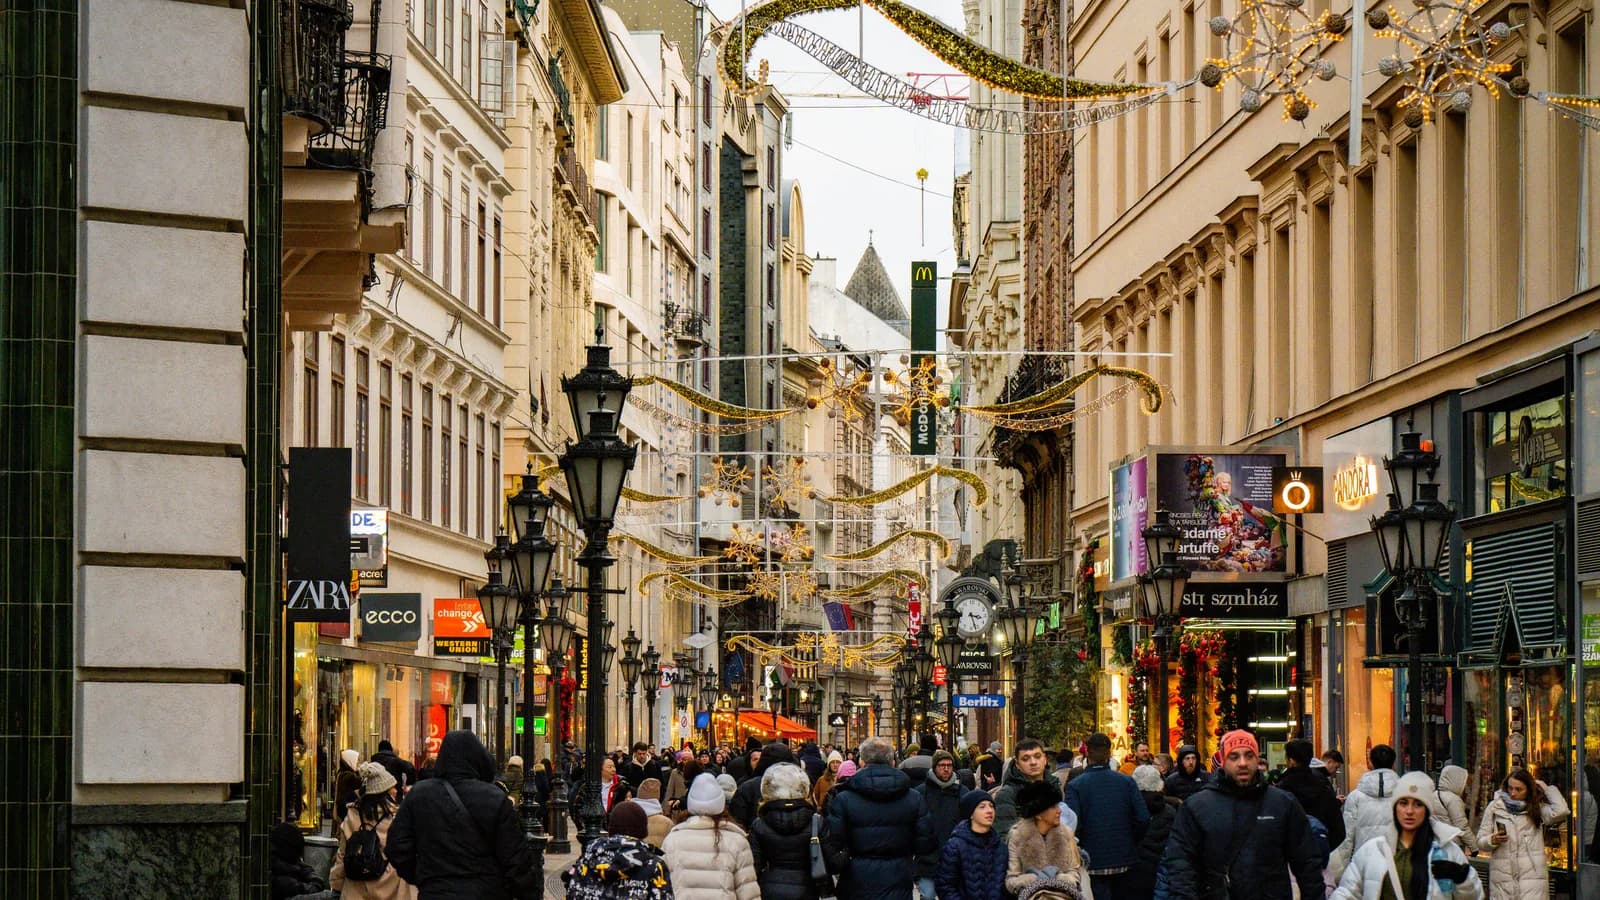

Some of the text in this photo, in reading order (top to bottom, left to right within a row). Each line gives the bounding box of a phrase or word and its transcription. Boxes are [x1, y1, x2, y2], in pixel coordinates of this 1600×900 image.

[1332, 464, 1374, 503] PANDORA
[1178, 542, 1220, 553] artuffe
[359, 570, 383, 578] ecret
[288, 580, 350, 610] ZARA
[1182, 591, 1205, 611] sti
[366, 610, 416, 624] ecco
[438, 609, 473, 619] change
[959, 696, 1000, 706] Berlitz
